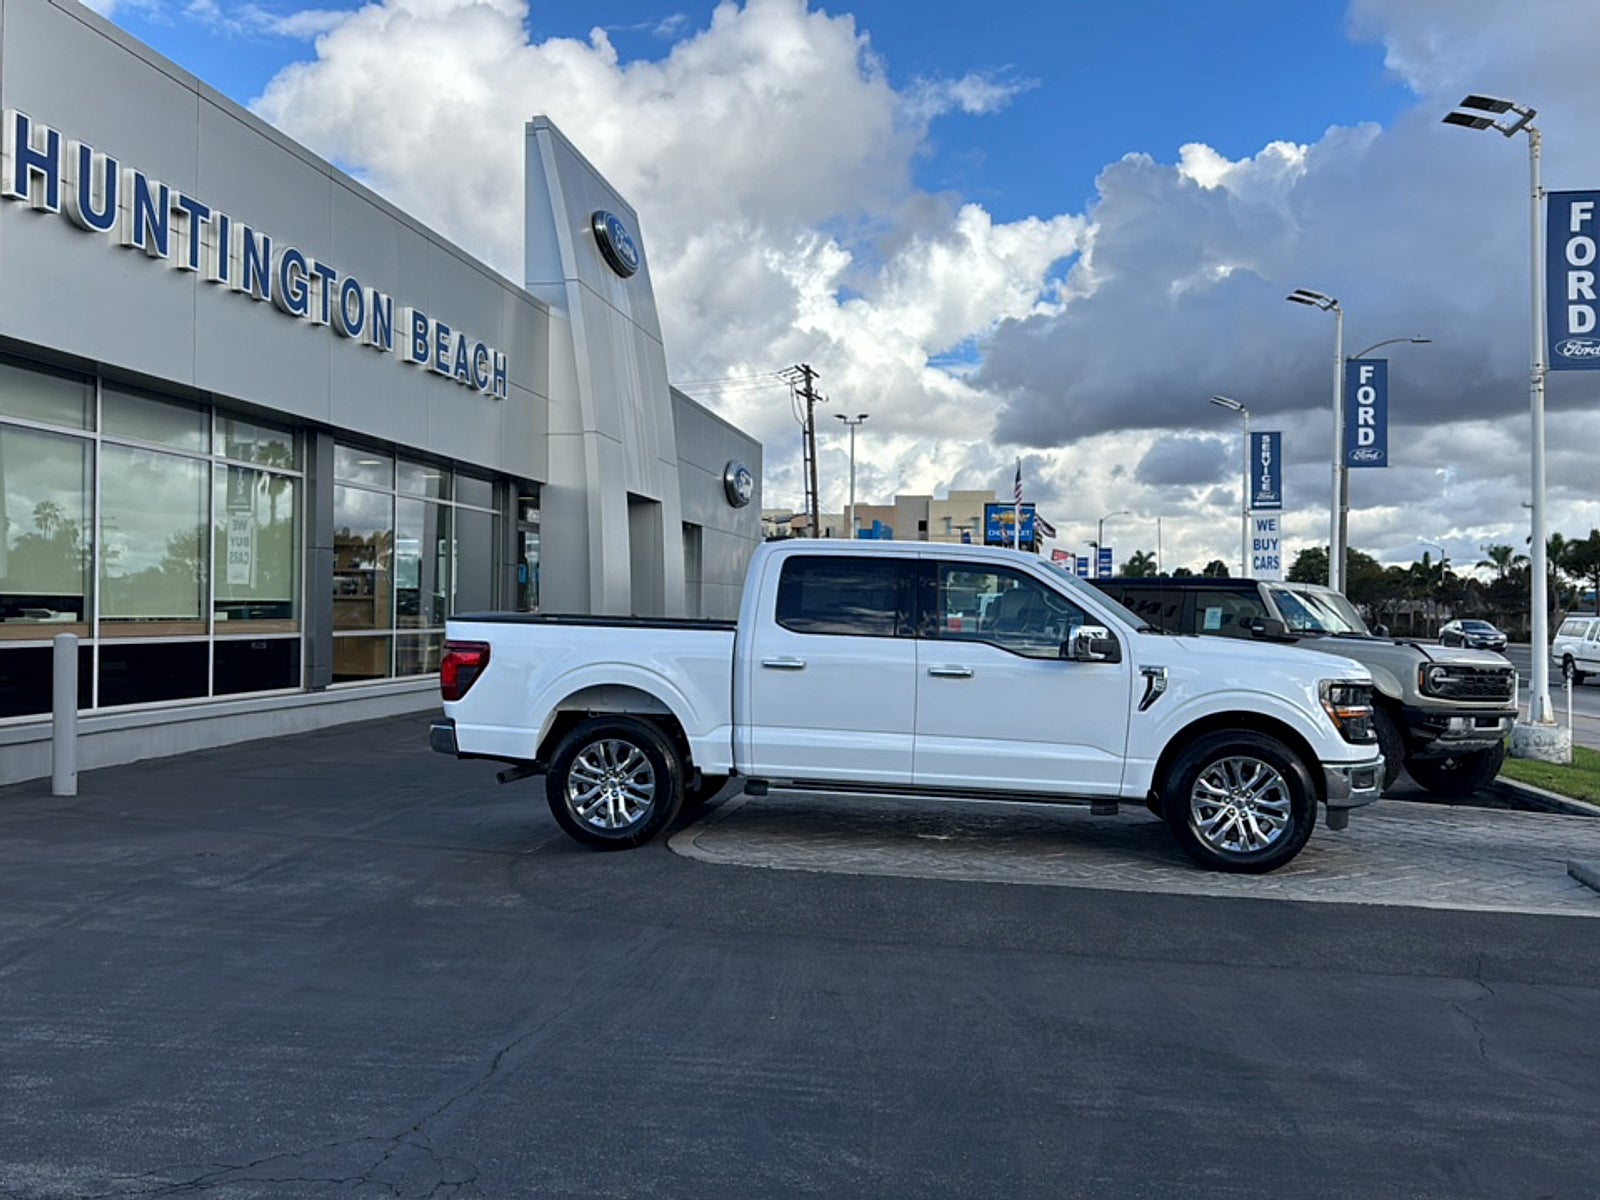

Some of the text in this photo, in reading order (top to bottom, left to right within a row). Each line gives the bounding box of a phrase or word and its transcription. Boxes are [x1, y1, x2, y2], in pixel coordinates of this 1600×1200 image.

[3, 109, 508, 399] HUNTINGTON BEACH
[1565, 201, 1597, 334] FORD
[1356, 365, 1376, 447] FORD
[1261, 434, 1272, 492] SERVICE
[1253, 538, 1278, 551] BUY
[1256, 519, 1276, 532] WE
[1253, 556, 1280, 570] CARS
